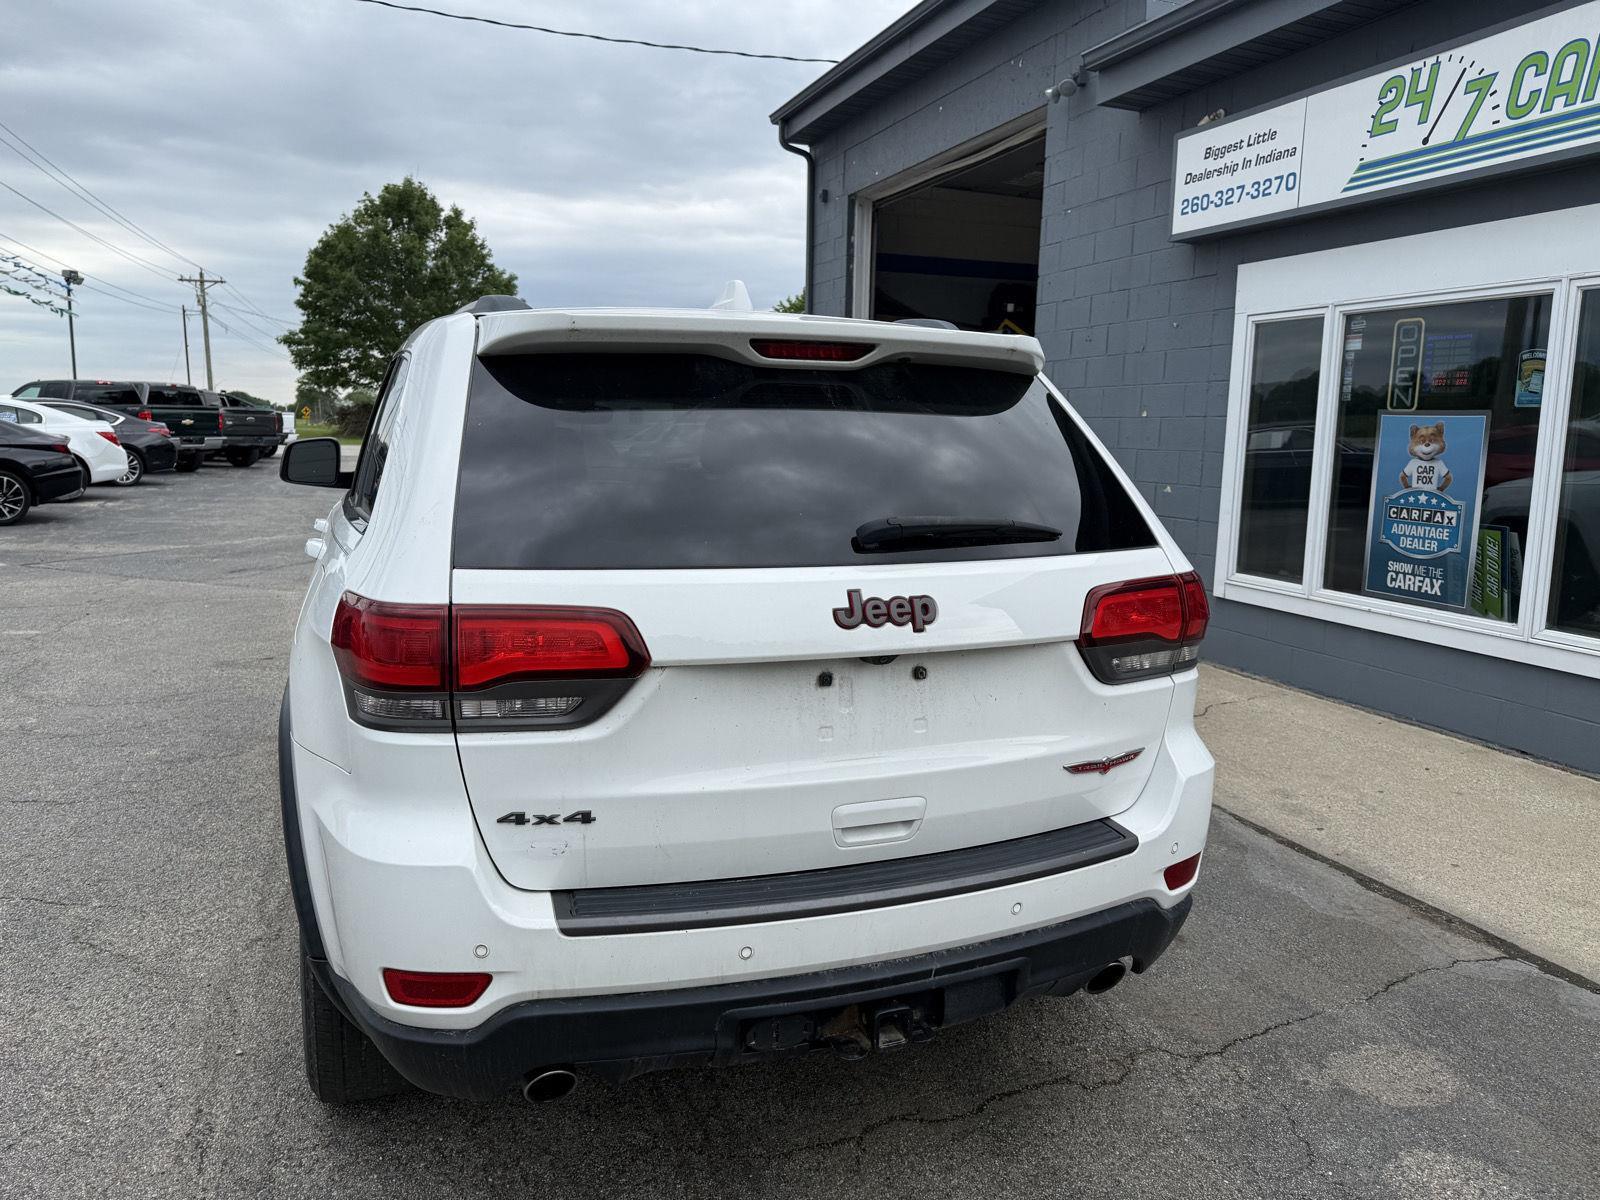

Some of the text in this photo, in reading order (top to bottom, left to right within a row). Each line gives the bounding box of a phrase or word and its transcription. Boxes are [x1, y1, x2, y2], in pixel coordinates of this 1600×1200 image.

[1204, 128, 1277, 160] Biggest Little
[1184, 146, 1297, 185] Dealership In Indiana
[1180, 172, 1297, 216] 260-327-3270
[1522, 351, 1547, 361] WELCOM
[1393, 325, 1419, 407] OPEN
[1416, 465, 1435, 475] CAR
[1416, 475, 1433, 485] FOX
[1388, 506, 1457, 526] CARFAX
[1391, 523, 1450, 540] ADVANTAGE
[1400, 536, 1438, 552] DEALER
[1387, 561, 1444, 579] SHOW ME THE
[1486, 559, 1499, 575] TO
[1386, 571, 1443, 596] CARFAX
[1486, 574, 1499, 599] CAR
[832, 588, 938, 633] Jeep
[496, 809, 597, 826] 4x4
